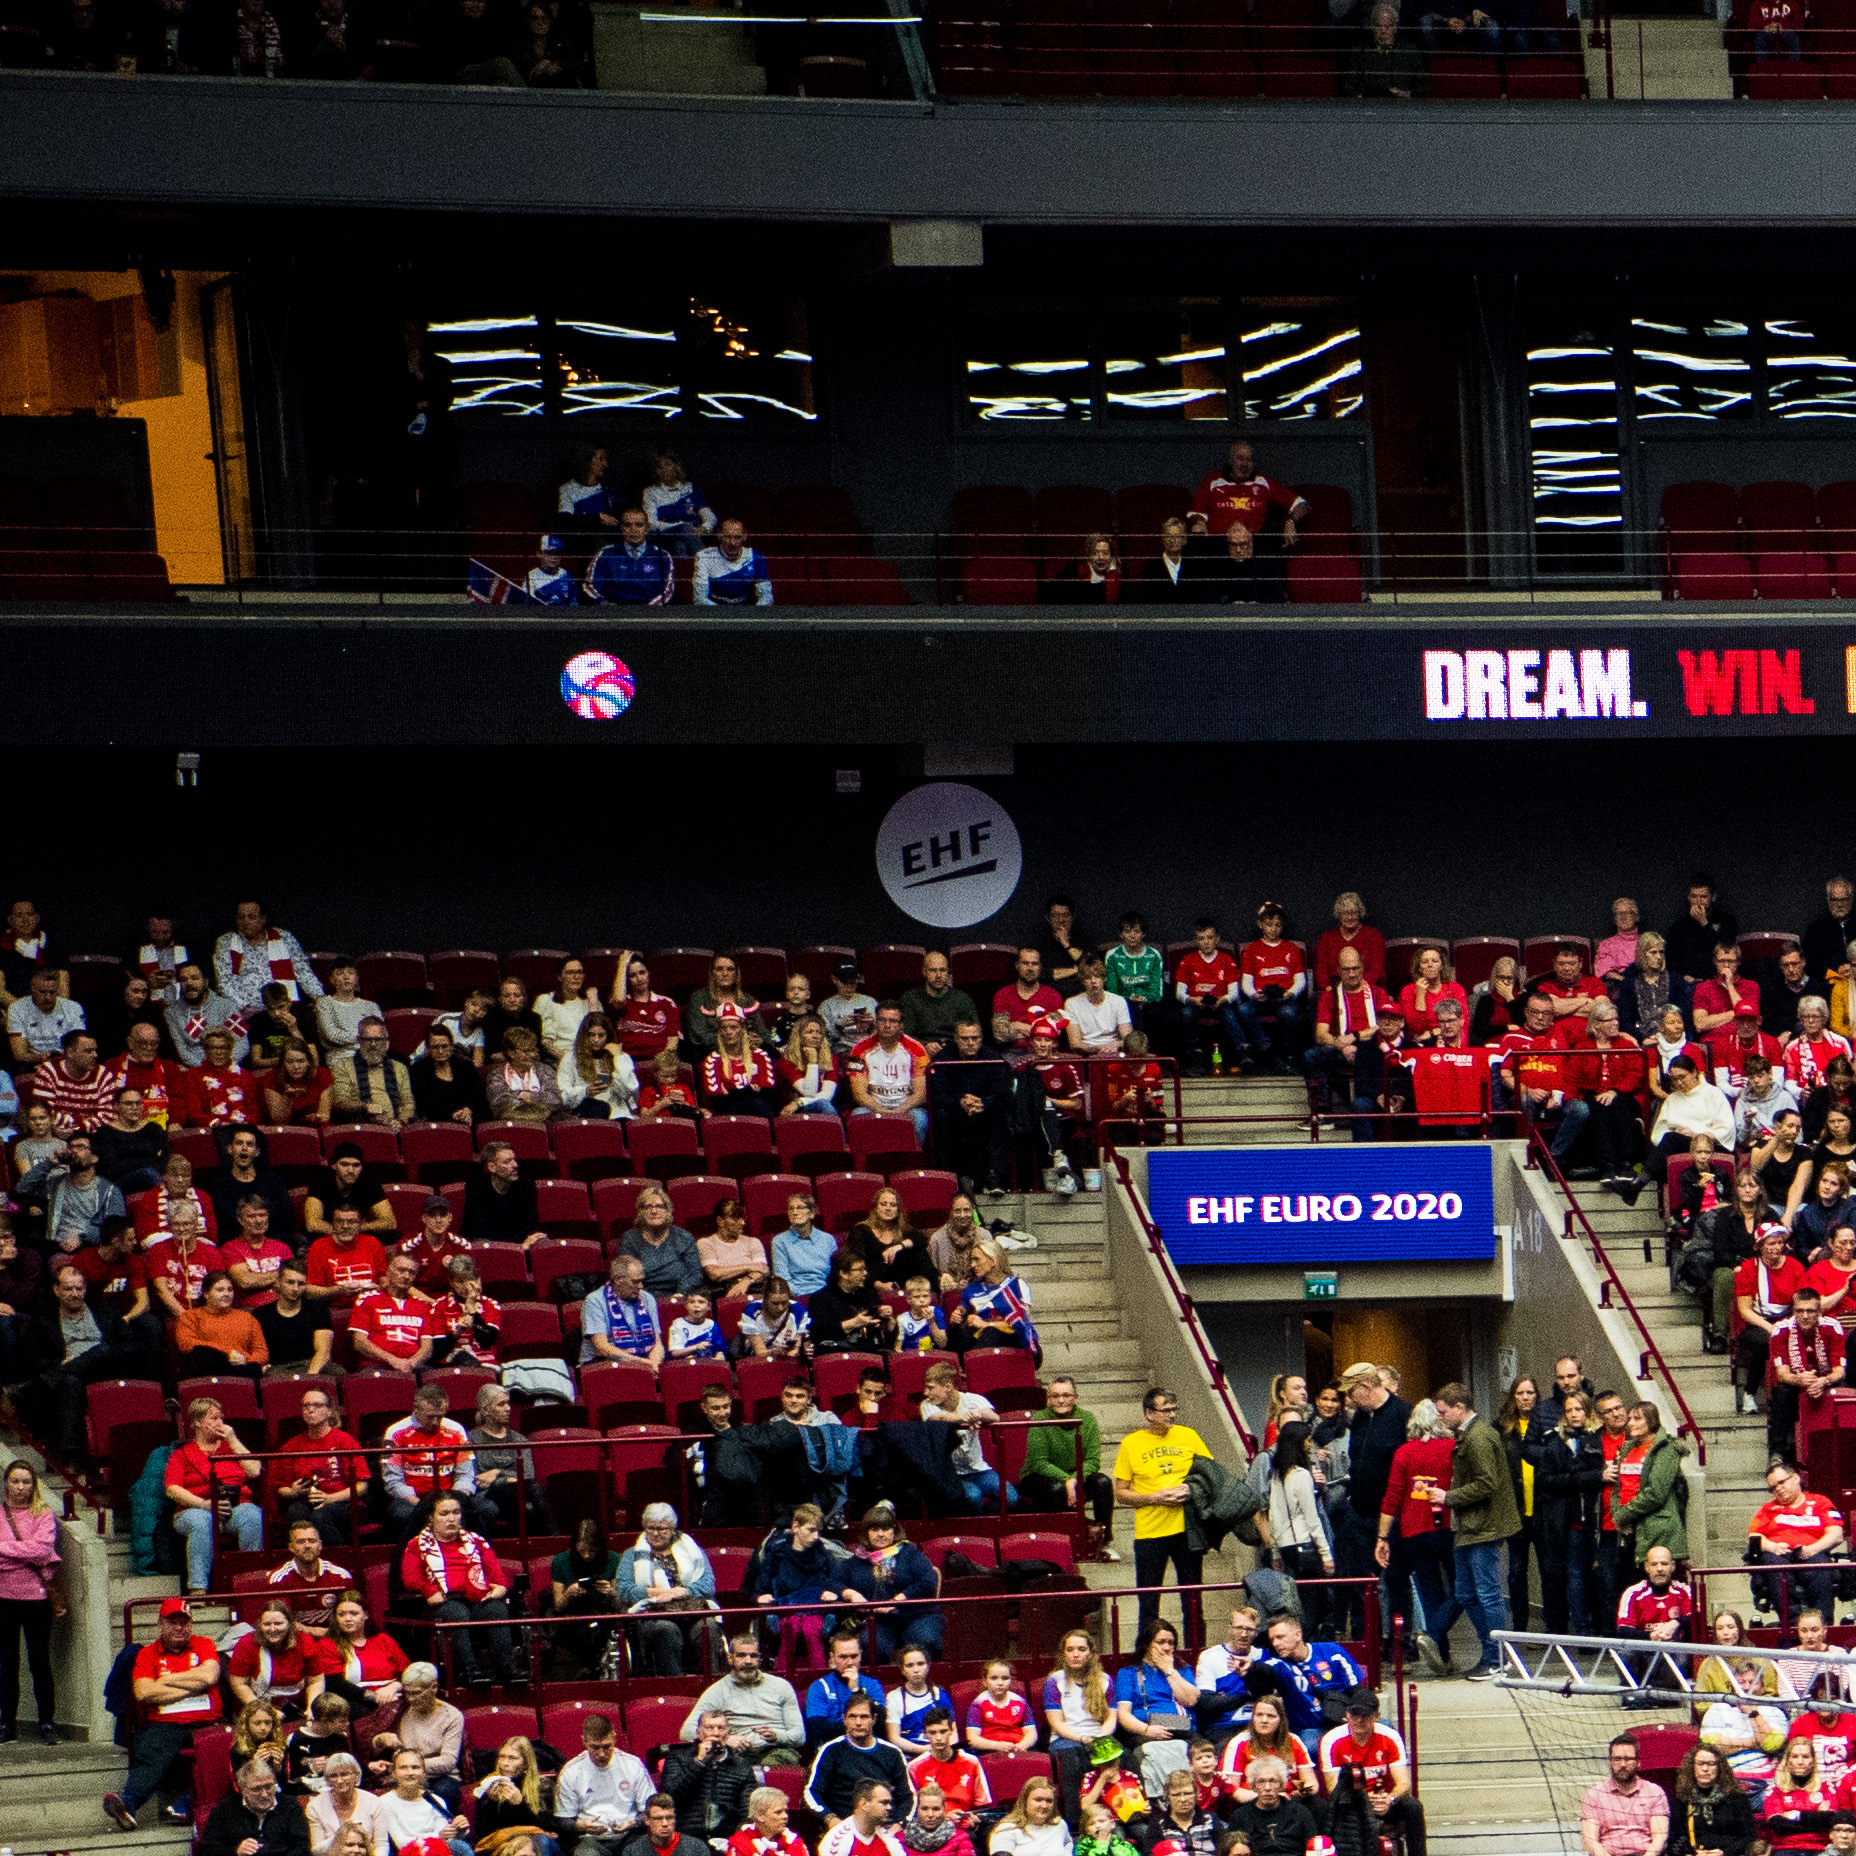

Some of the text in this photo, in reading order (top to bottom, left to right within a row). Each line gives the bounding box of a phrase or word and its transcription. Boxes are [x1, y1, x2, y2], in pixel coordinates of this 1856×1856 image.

[1424, 648, 1650, 719] DREAM.
[1678, 650, 1815, 716] WIN.
[901, 820, 992, 877] EHF
[1188, 1192, 1463, 1225] EHF EURO 2020
